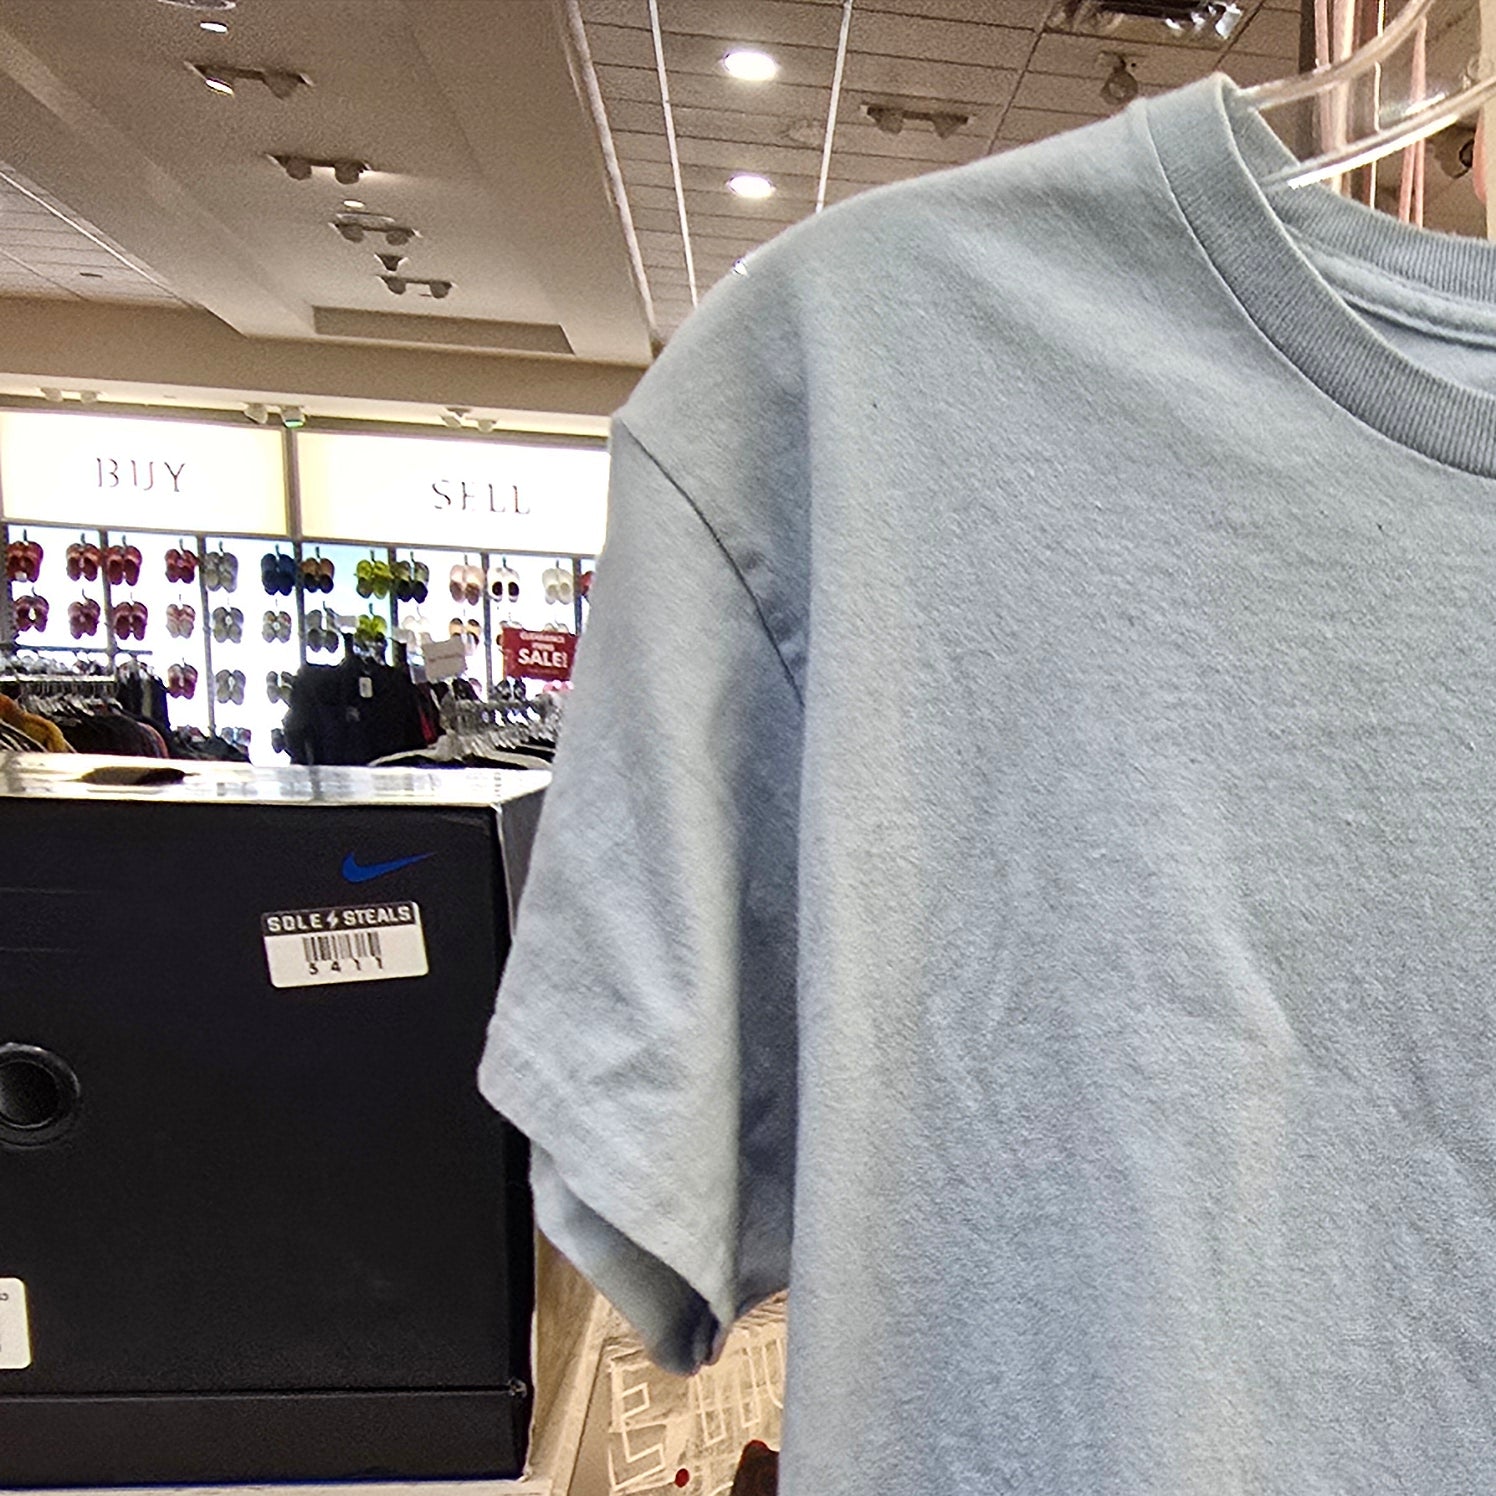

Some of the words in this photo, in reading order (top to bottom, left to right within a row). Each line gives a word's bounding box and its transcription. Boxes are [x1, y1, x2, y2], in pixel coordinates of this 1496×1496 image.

[96, 457, 186, 493] BUY
[431, 479, 531, 515] SELL
[266, 912, 323, 933] SOLE
[342, 905, 412, 926] STEALS
